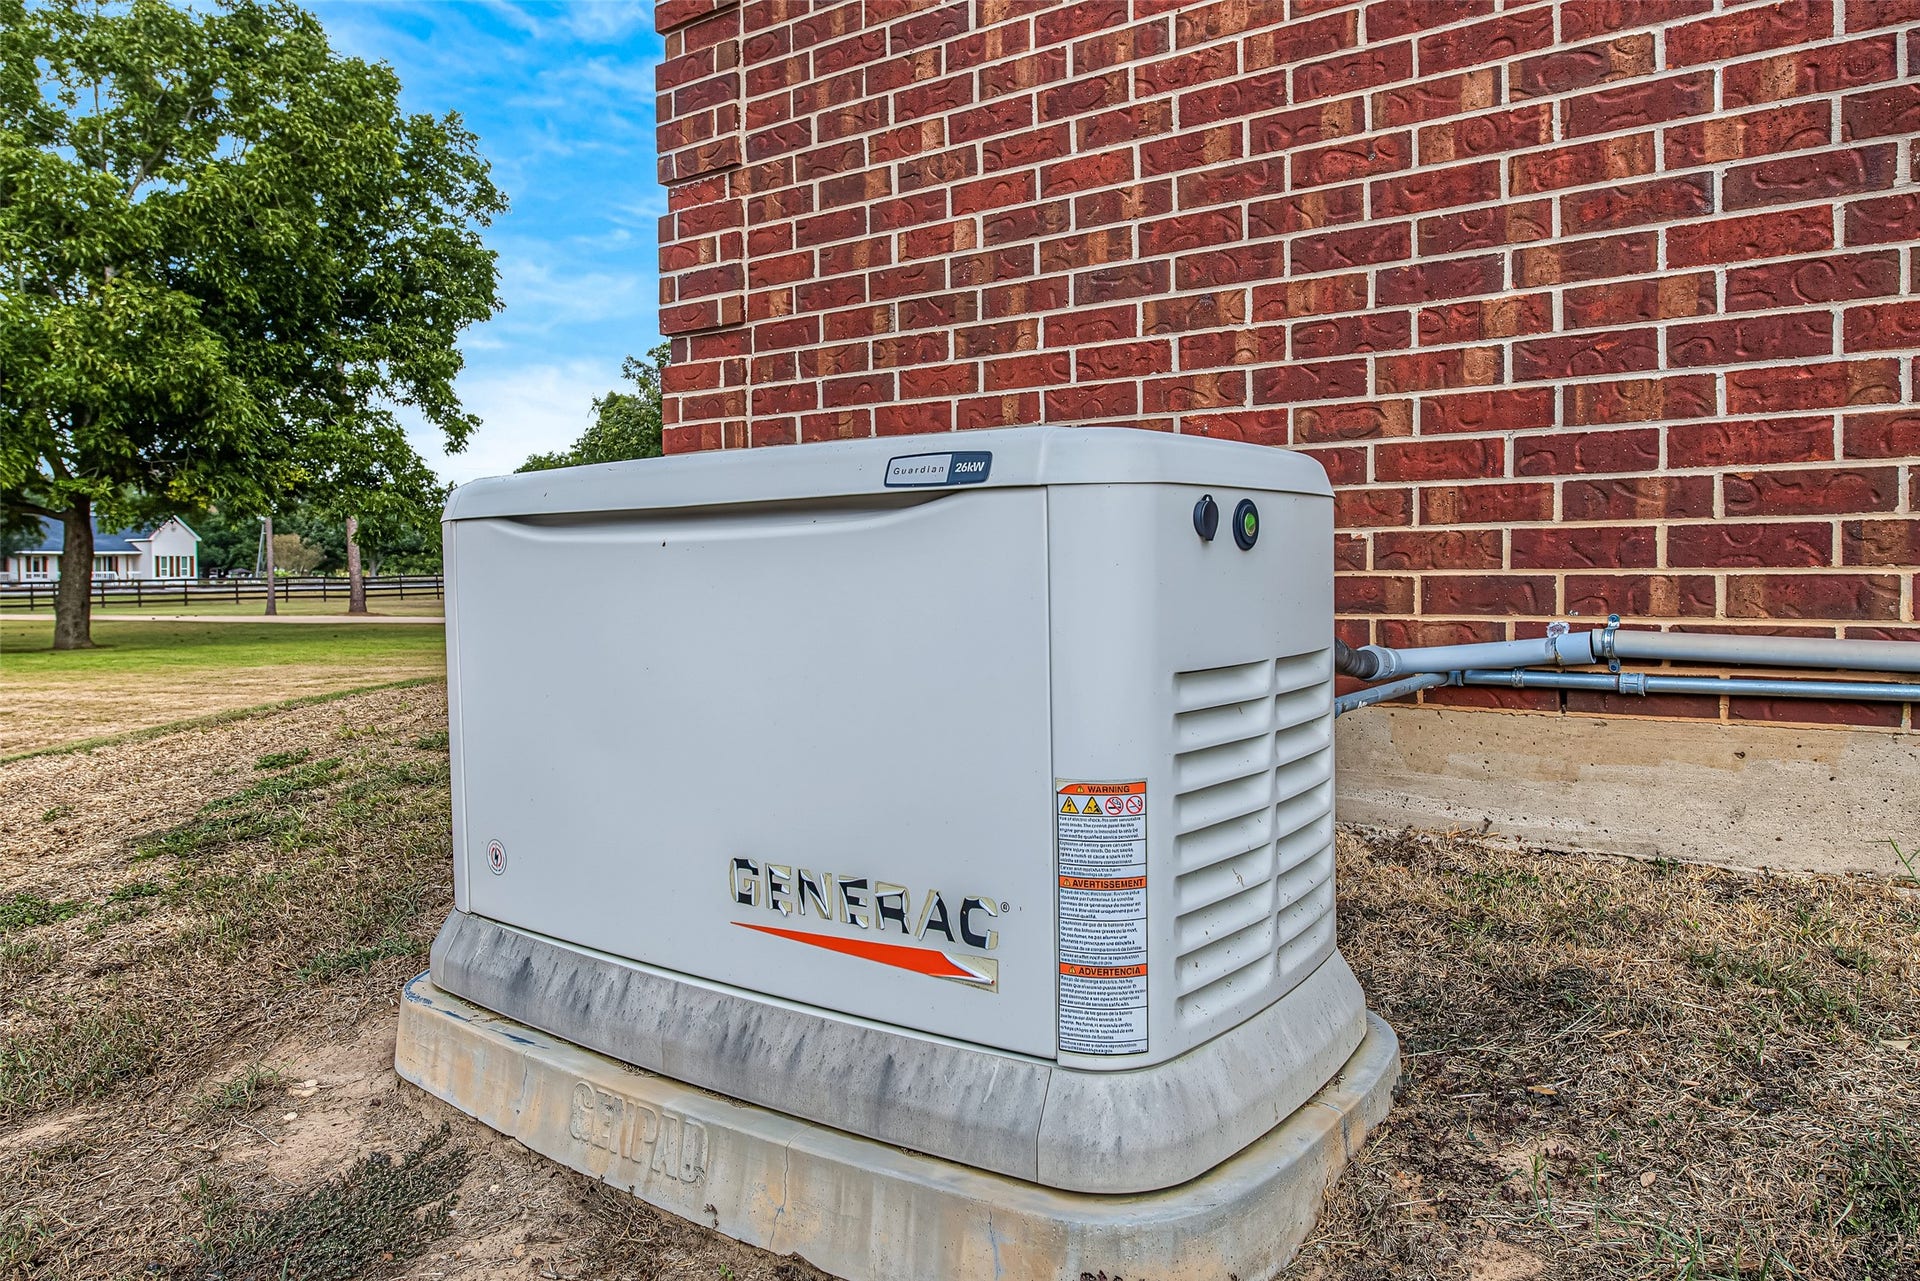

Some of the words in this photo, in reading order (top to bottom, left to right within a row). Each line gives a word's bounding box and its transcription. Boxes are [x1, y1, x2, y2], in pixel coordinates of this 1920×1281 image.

[893, 465, 944, 475] Guardian
[954, 461, 985, 473] 26kW
[1087, 785, 1130, 793] WARNING
[1072, 879, 1144, 889] AVERTISSEMENT
[729, 858, 999, 950] GENERAC
[1078, 967, 1141, 976] ADVERTENCIA
